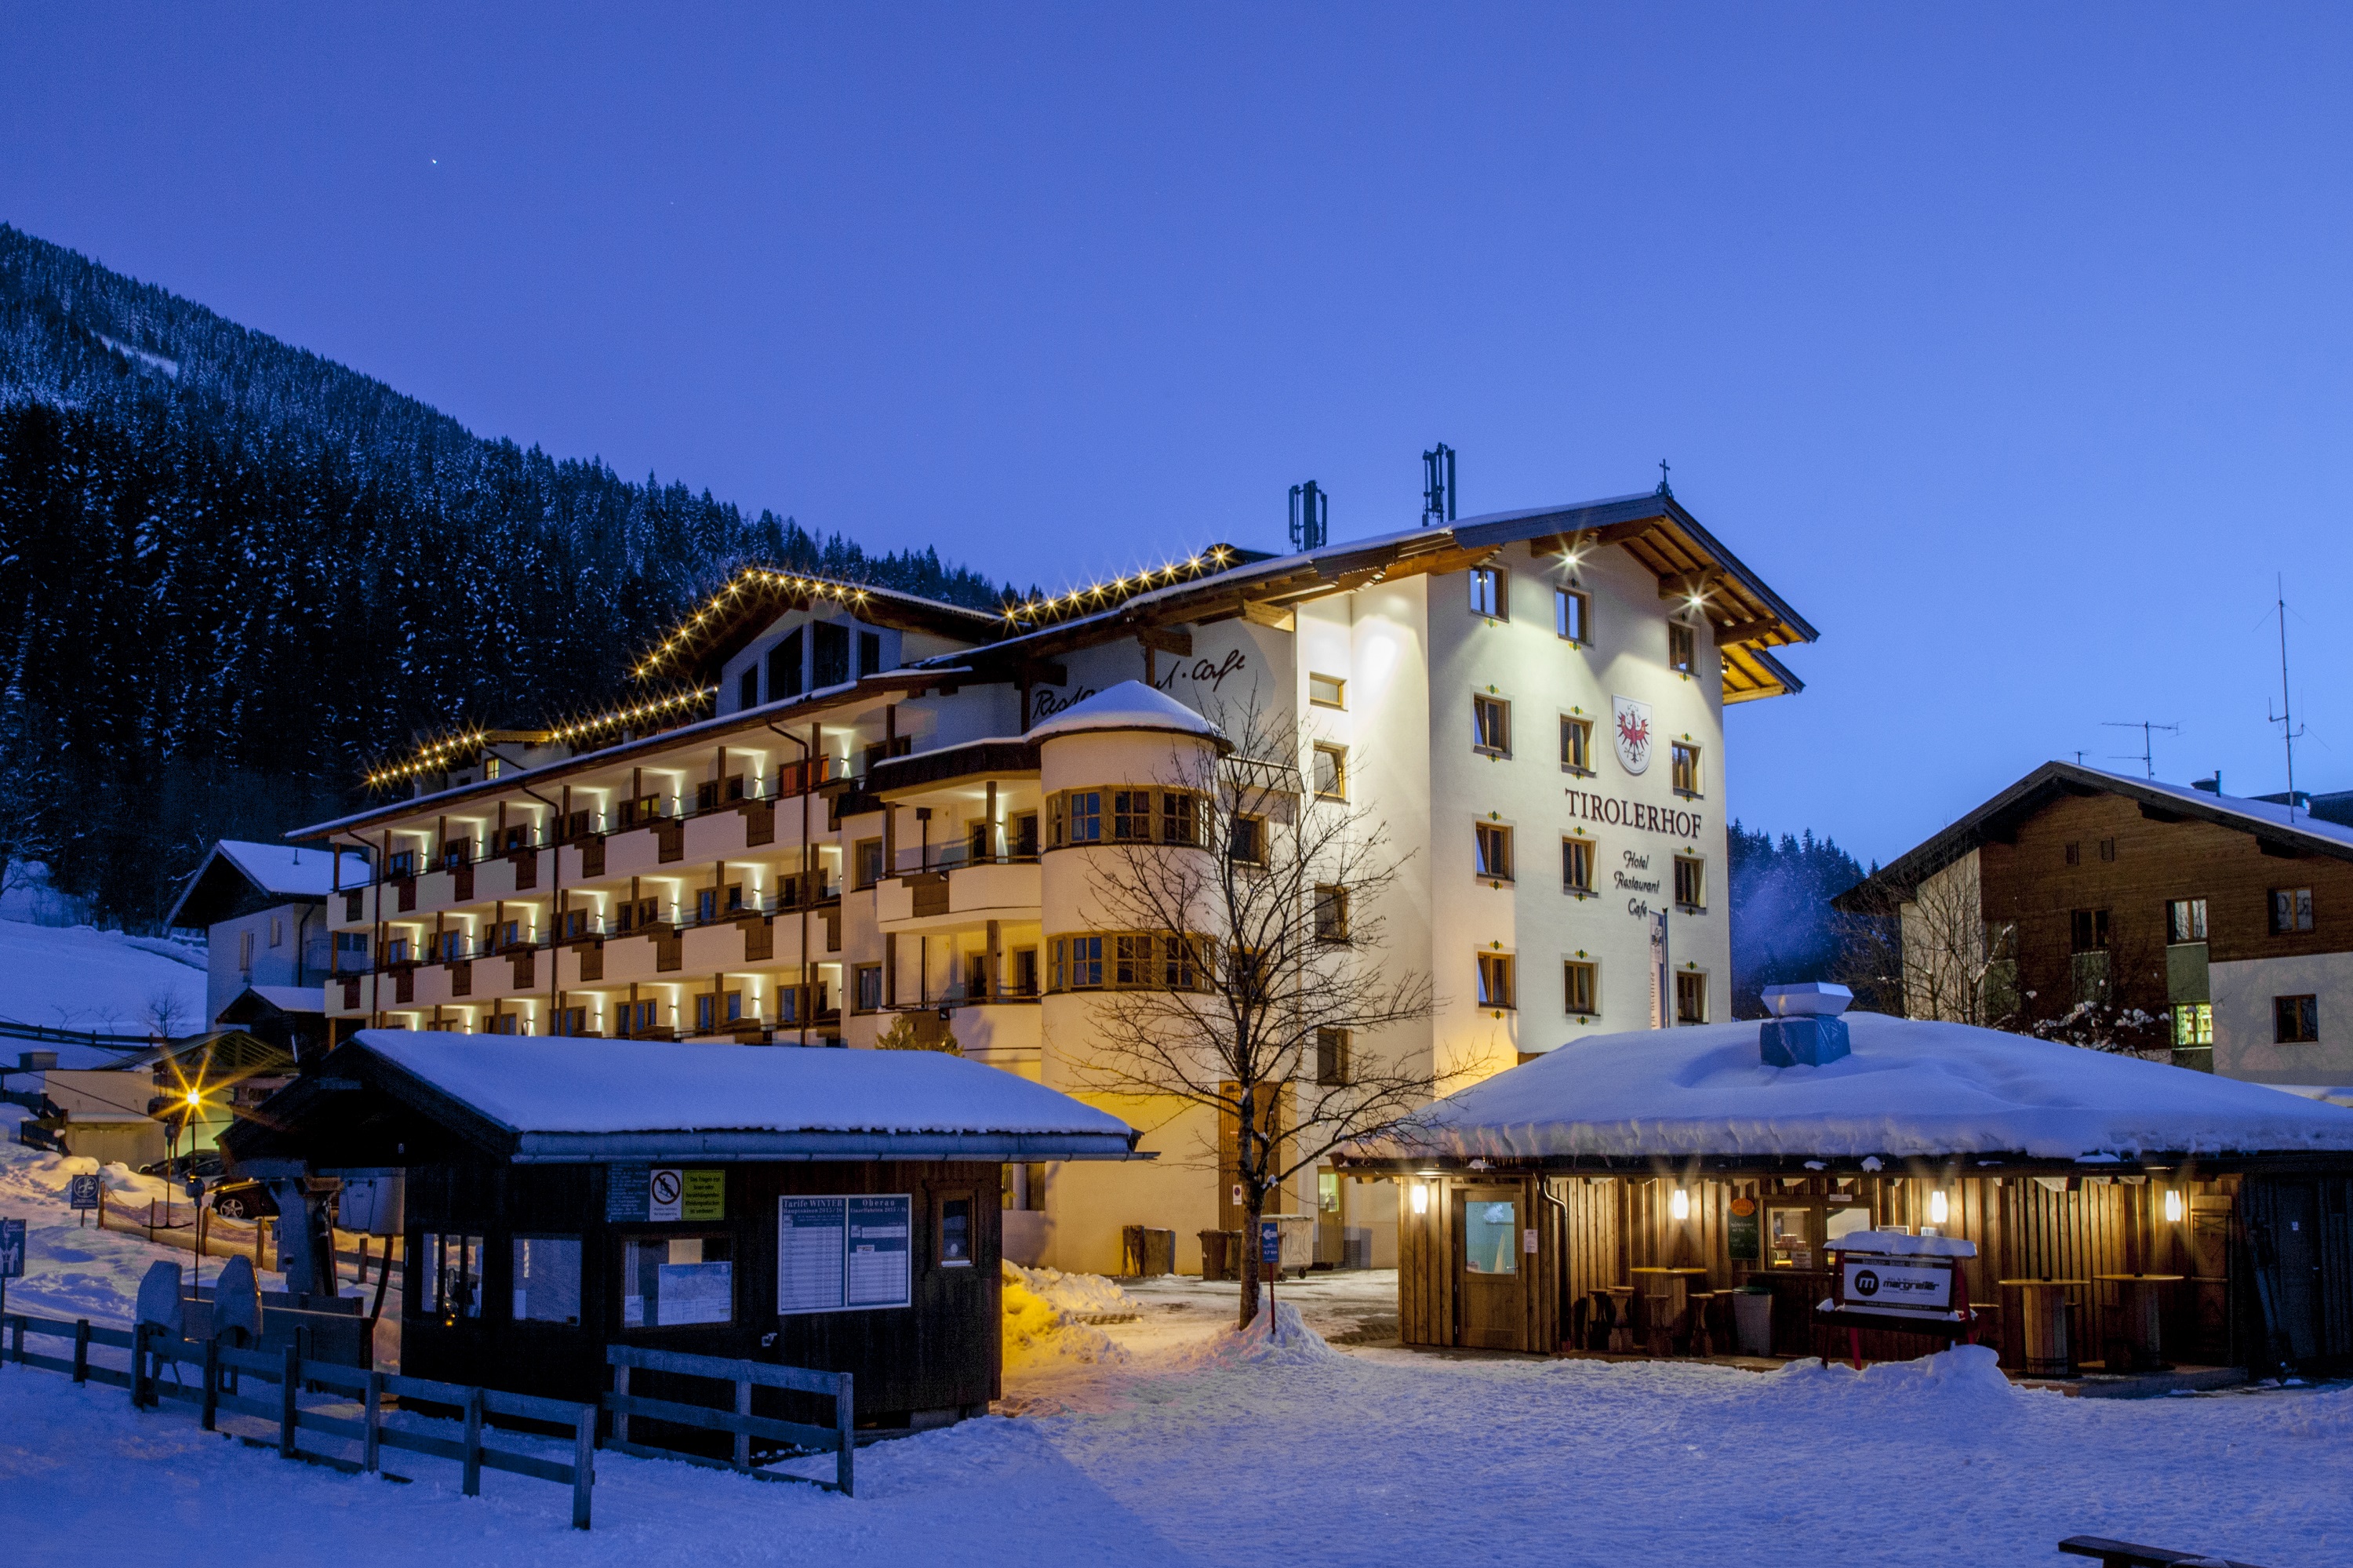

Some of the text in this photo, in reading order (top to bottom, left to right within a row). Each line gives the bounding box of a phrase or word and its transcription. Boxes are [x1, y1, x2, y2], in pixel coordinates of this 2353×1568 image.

[1565, 787, 1701, 839] TIROLERHOF
[1623, 850, 1649, 870] Hotel
[1613, 871, 1660, 894] Restaurant
[784, 1199, 808, 1208] Tarife
[863, 1199, 896, 1207] Oberau
